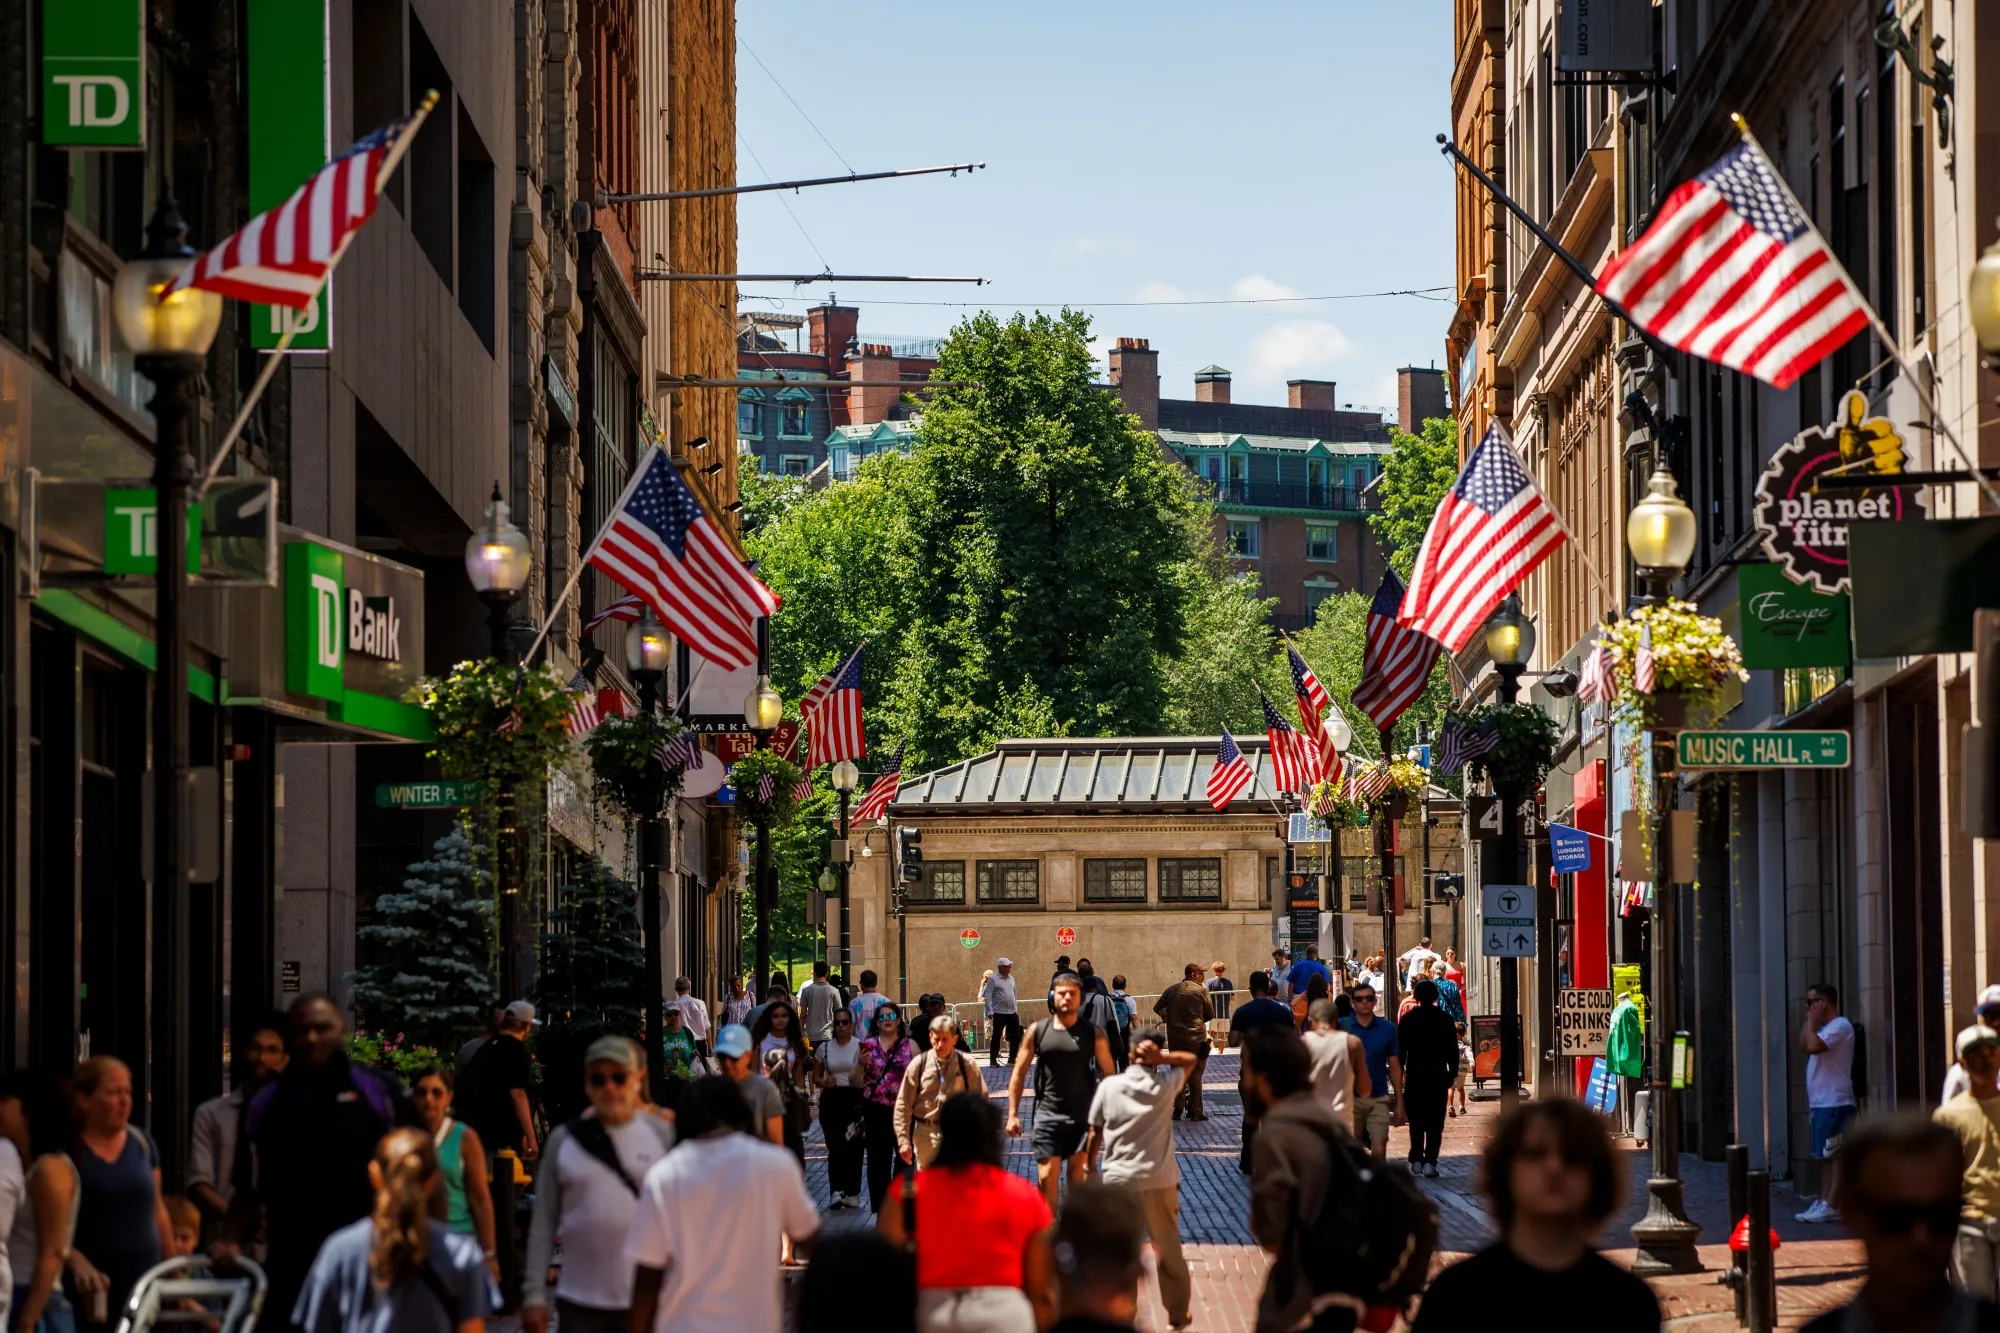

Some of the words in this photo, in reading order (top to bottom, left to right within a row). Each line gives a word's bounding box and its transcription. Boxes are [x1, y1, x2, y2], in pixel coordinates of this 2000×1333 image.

[52, 75, 130, 127] TD
[1778, 491, 1891, 527] planet
[311, 573, 342, 669] TD
[348, 588, 401, 662] Bank
[1748, 591, 1831, 642] Escape
[690, 723, 749, 731] MARKE
[728, 738, 787, 753] Tailrs
[1686, 737, 1746, 763] MUSIC
[1753, 737, 1799, 763] HALL
[1802, 749, 1814, 763] PL
[389, 785, 440, 803] WINTER
[445, 787, 458, 800] PL
[1557, 846, 1585, 854] LUGGAGE
[1558, 853, 1586, 861] STORAGE
[1487, 918, 1513, 926] GREEN
[967, 930, 973, 938] F
[1063, 928, 1069, 936] F
[1561, 991, 1586, 1009] ICE
[1587, 991, 1611, 1009] COLD
[1562, 1011, 1612, 1029] DRINKS
